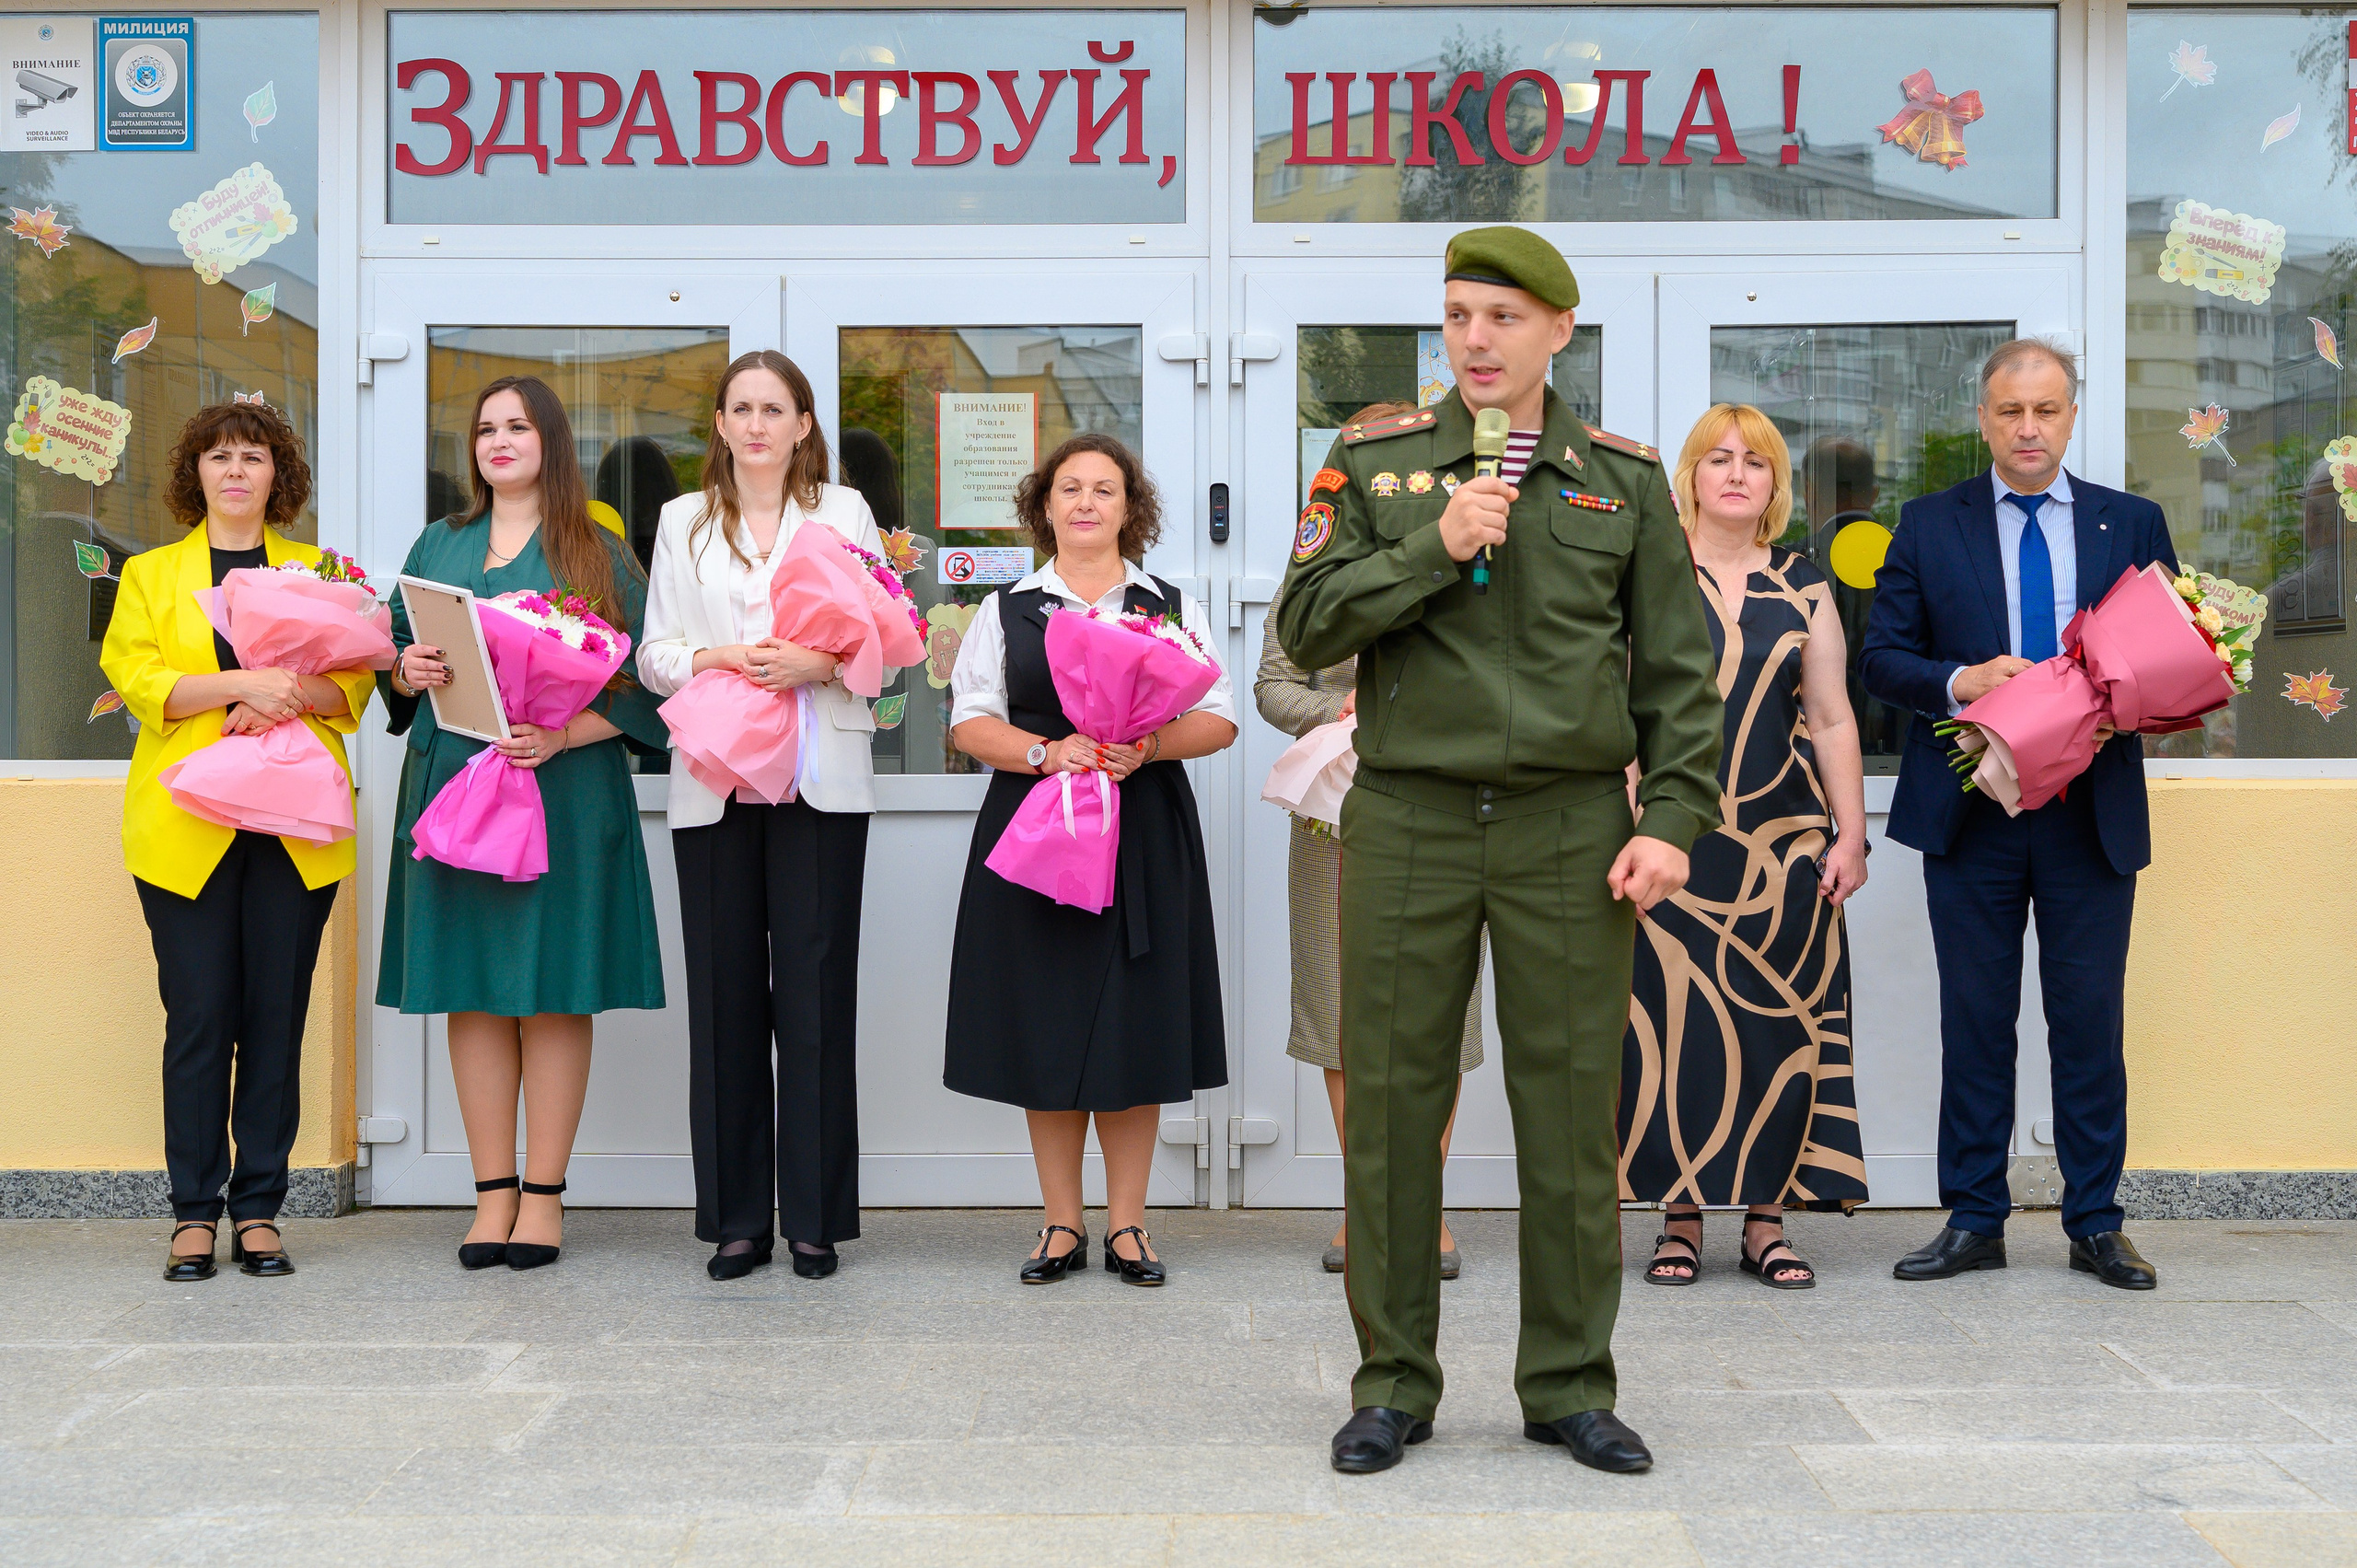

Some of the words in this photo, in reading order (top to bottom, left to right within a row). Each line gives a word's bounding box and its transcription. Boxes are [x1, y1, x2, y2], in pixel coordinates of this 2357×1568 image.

[104, 22, 189, 36] МИЛИЦИЯ
[12, 59, 81, 69] ВНИМАНИЕ
[395, 41, 1178, 188] ЗДРАВСТВУЙ,
[58, 394, 88, 413] уже
[90, 406, 122, 429] жду
[953, 402, 1027, 412] ВНИМАНИЕ!
[56, 412, 114, 440] осенние
[977, 418, 998, 426] Вход
[965, 433, 1016, 441] учреждение
[963, 444, 1018, 453] образования
[954, 459, 995, 467] разрешен
